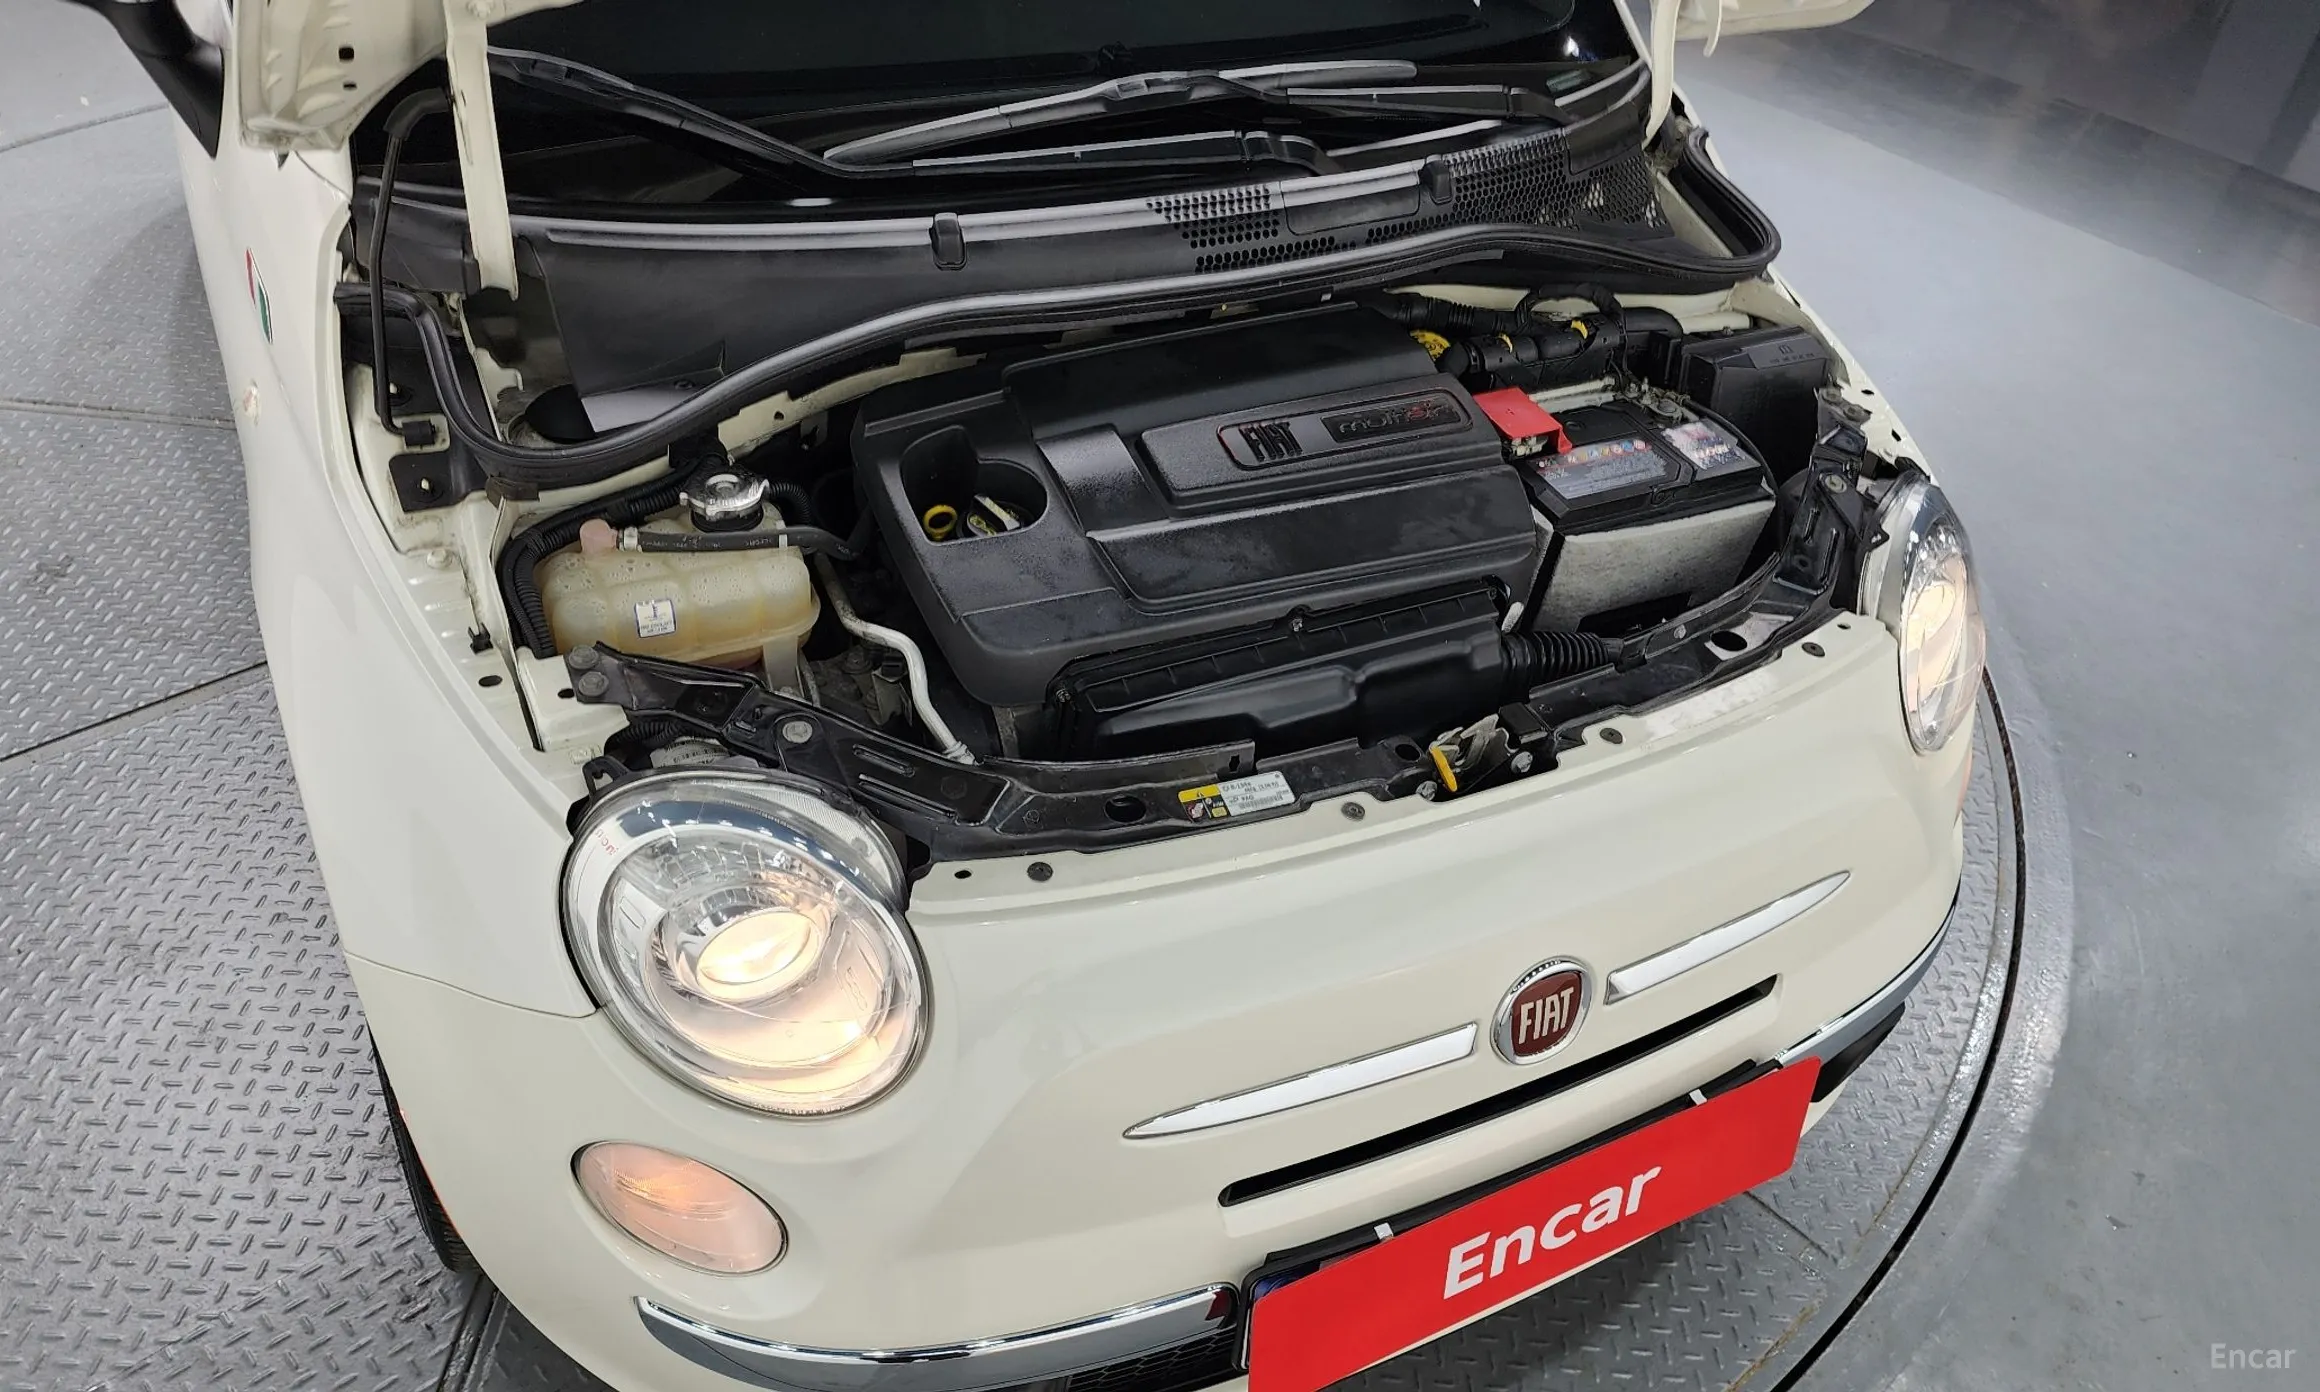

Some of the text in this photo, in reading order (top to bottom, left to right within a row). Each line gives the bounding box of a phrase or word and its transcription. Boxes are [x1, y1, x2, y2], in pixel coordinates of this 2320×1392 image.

[1238, 419, 1303, 464] FIAT
[1518, 986, 1575, 1045] FIAT
[1443, 1165, 1663, 1301] Encar
